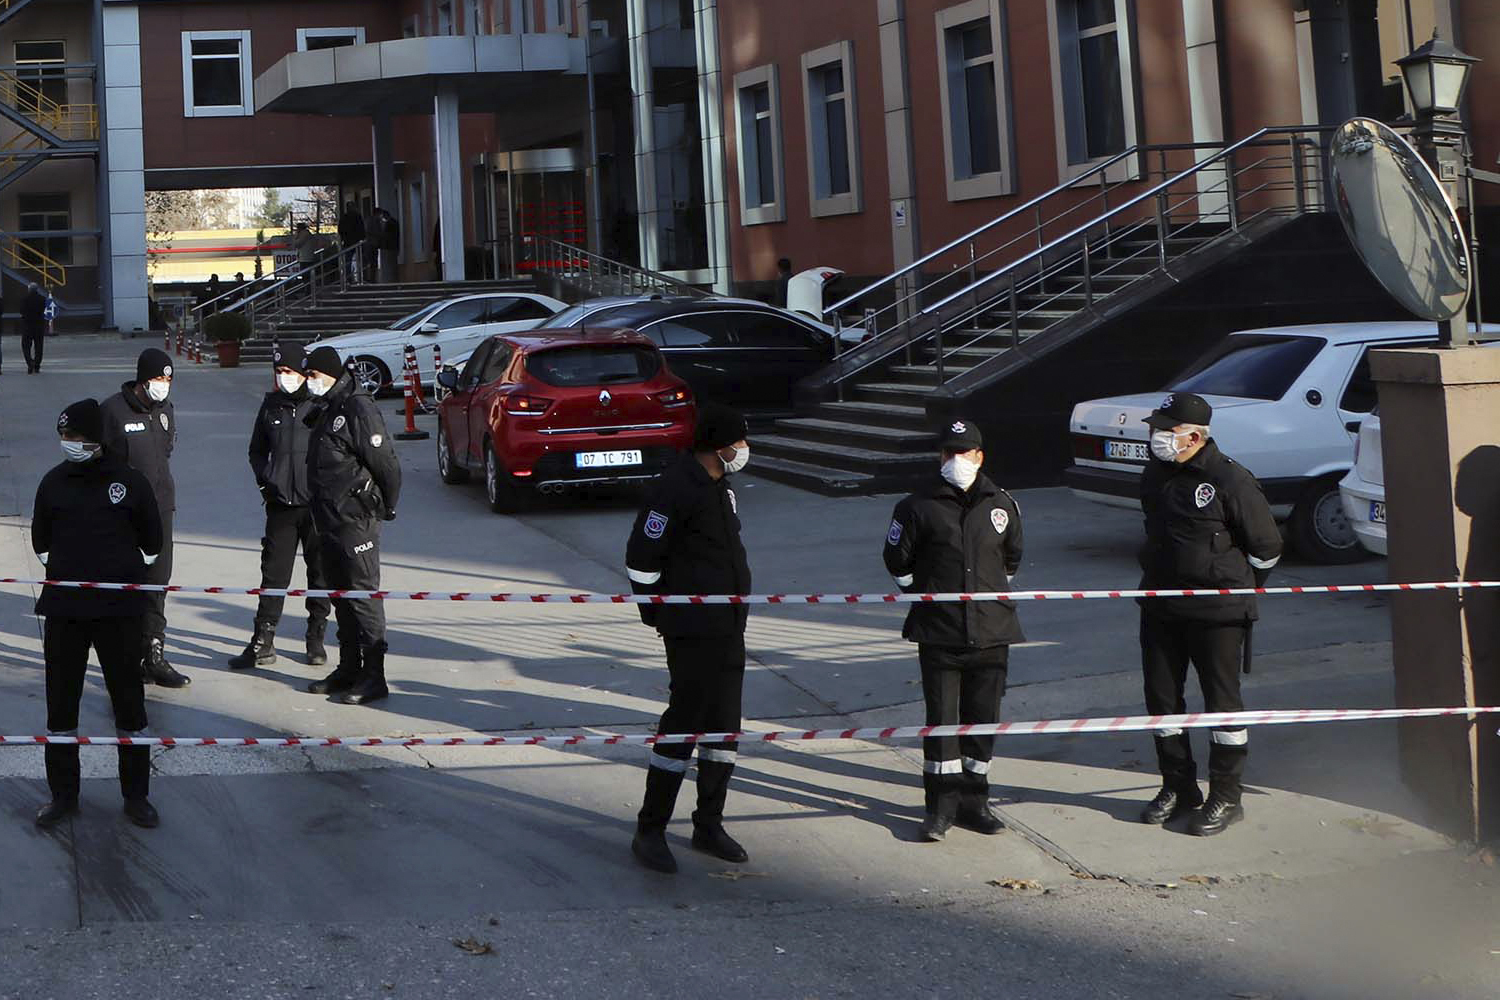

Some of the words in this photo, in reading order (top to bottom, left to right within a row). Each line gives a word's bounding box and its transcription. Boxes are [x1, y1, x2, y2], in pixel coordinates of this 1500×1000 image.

[1110, 443, 1119, 456] 27
[584, 454, 595, 464] 07
[603, 453, 614, 463] TC
[621, 452, 638, 463] 791
[1374, 504, 1385, 520] 34
